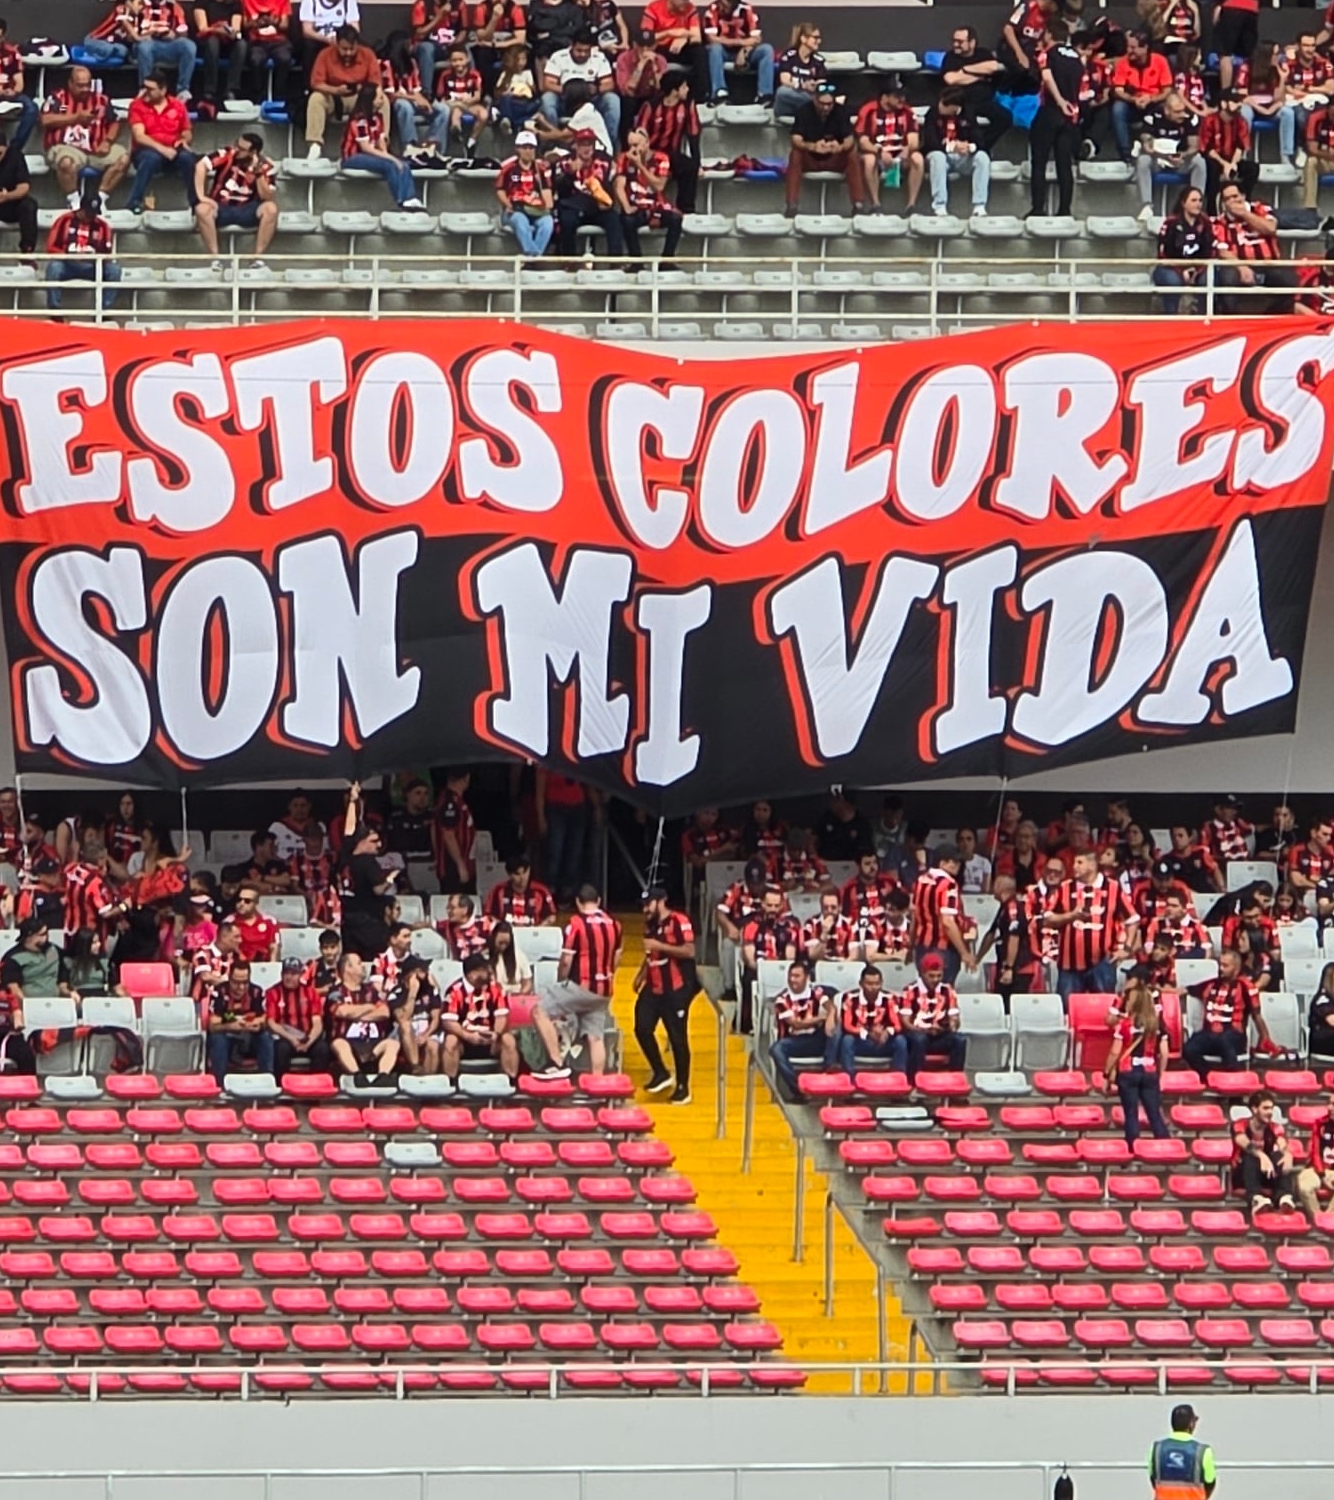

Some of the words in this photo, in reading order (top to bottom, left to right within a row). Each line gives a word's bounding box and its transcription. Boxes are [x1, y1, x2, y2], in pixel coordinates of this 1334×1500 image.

[3, 337, 563, 532] ESTOS
[26, 531, 422, 765] SON
[477, 543, 712, 787] MI
[771, 519, 1294, 758] VIDA
